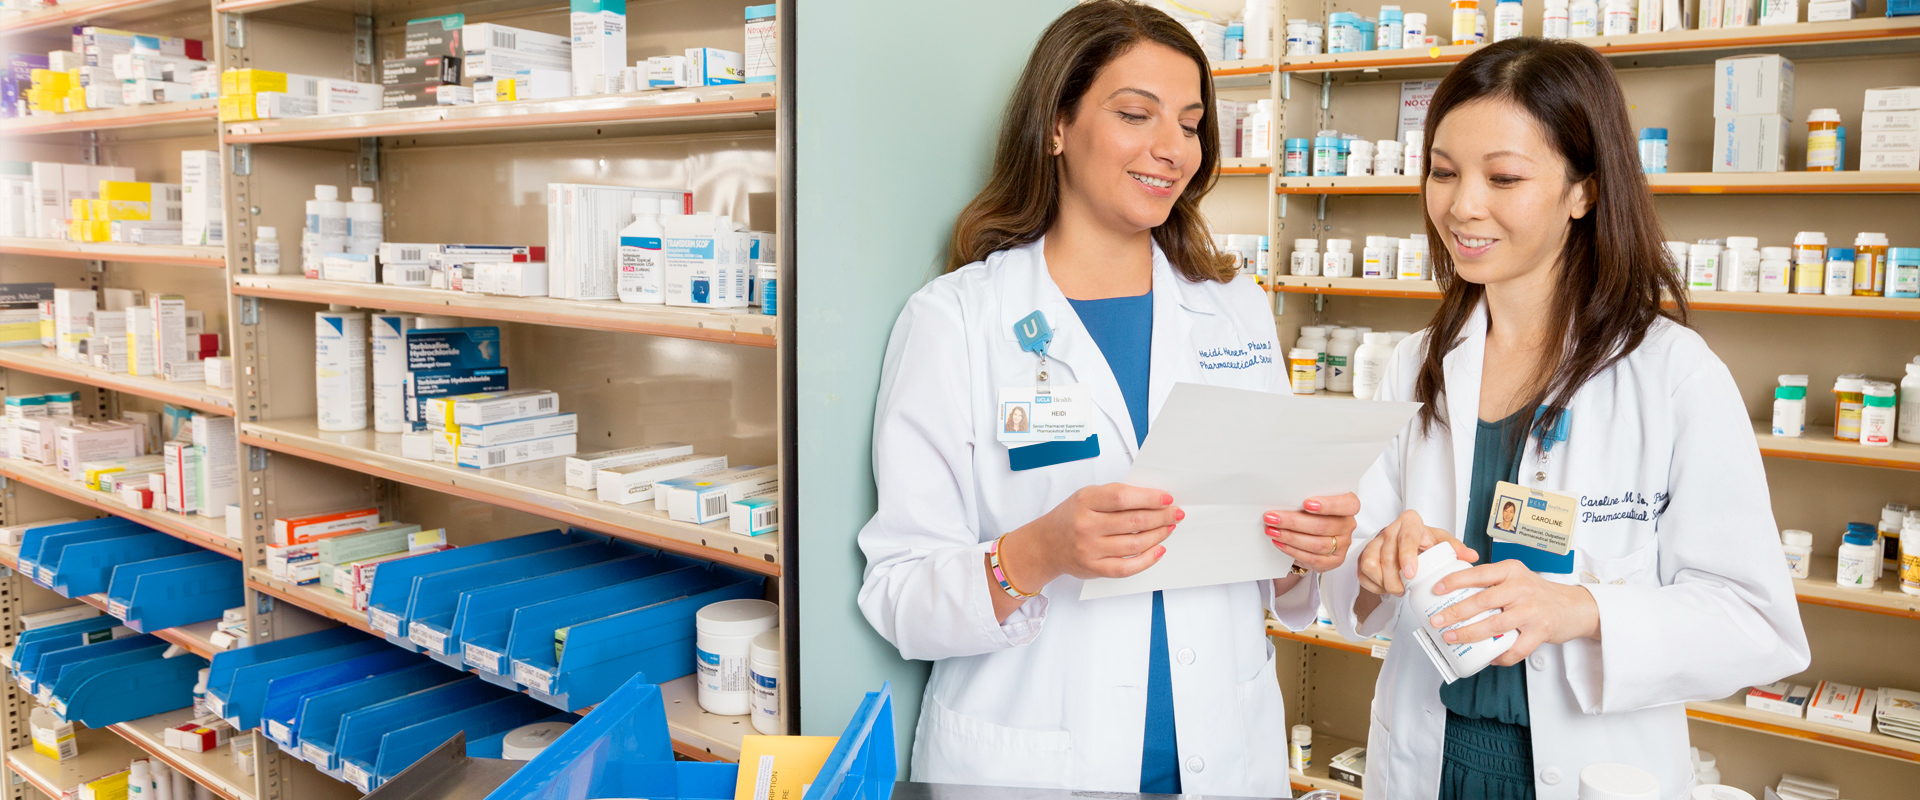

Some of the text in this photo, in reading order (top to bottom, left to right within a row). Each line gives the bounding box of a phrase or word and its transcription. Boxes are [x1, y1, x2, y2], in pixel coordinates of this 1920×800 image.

[1726, 66, 1734, 76] 10
[1727, 123, 1735, 133] 10
[1023, 318, 1038, 338] U
[410, 348, 460, 357] Hydrochloride
[1199, 347, 1223, 358] Heidi
[1199, 355, 1259, 370] Pharmaceutical
[450, 376, 490, 385] Hydrochloride
[1580, 496, 1620, 506] Caroline
[1622, 491, 1634, 502] M
[1548, 504, 1569, 512] Healthcare
[1531, 514, 1563, 527] CAROLINE
[1582, 508, 1649, 523] Pharmaceutical
[1519, 531, 1548, 542] Pharmaceutical
[1544, 532, 1566, 541] Outpatient
